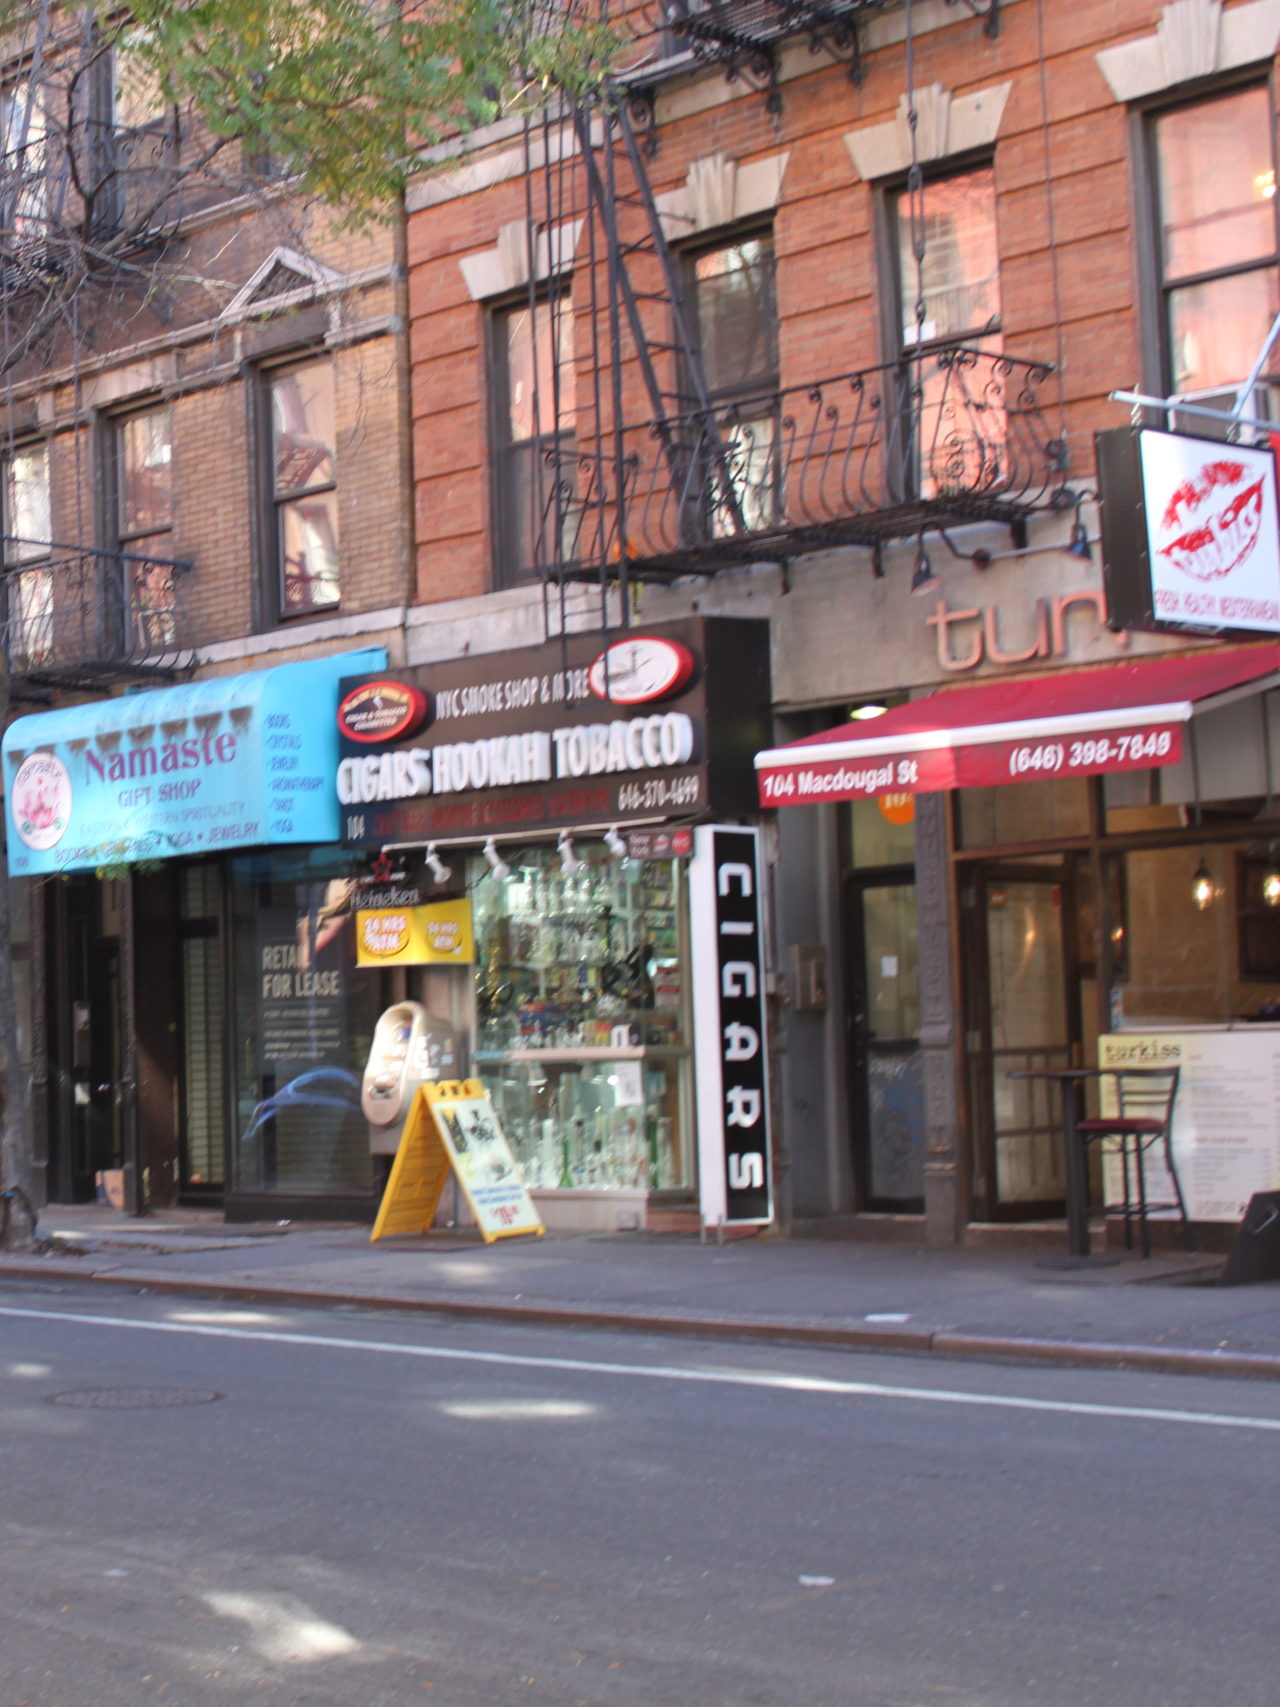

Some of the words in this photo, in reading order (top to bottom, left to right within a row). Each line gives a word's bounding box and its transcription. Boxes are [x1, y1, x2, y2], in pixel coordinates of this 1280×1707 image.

[436, 687, 462, 719] NYC
[462, 680, 504, 717] SMOKE
[506, 676, 538, 710] SHOP
[540, 674, 551, 702] &
[84, 729, 238, 786] Namaste
[336, 747, 432, 805] CIGARS
[432, 731, 551, 794] HOOKAH
[553, 711, 694, 779] TOBACCO
[1009, 742, 1064, 776] (646)
[1069, 730, 1172, 767] 398-7849
[118, 786, 152, 808] GIFT
[157, 778, 202, 803] SHOP
[764, 774, 795, 797] 104
[798, 763, 893, 795] Macdougal
[897, 760, 918, 784] St
[208, 821, 261, 843] JEWELRY
[349, 886, 420, 911] Heineken
[262, 944, 311, 970] RETAIL
[262, 974, 292, 999] FOR
[295, 970, 340, 997] LEASE
[718, 861, 764, 1190] CIGARS
[1104, 1038, 1182, 1061] turkiss
